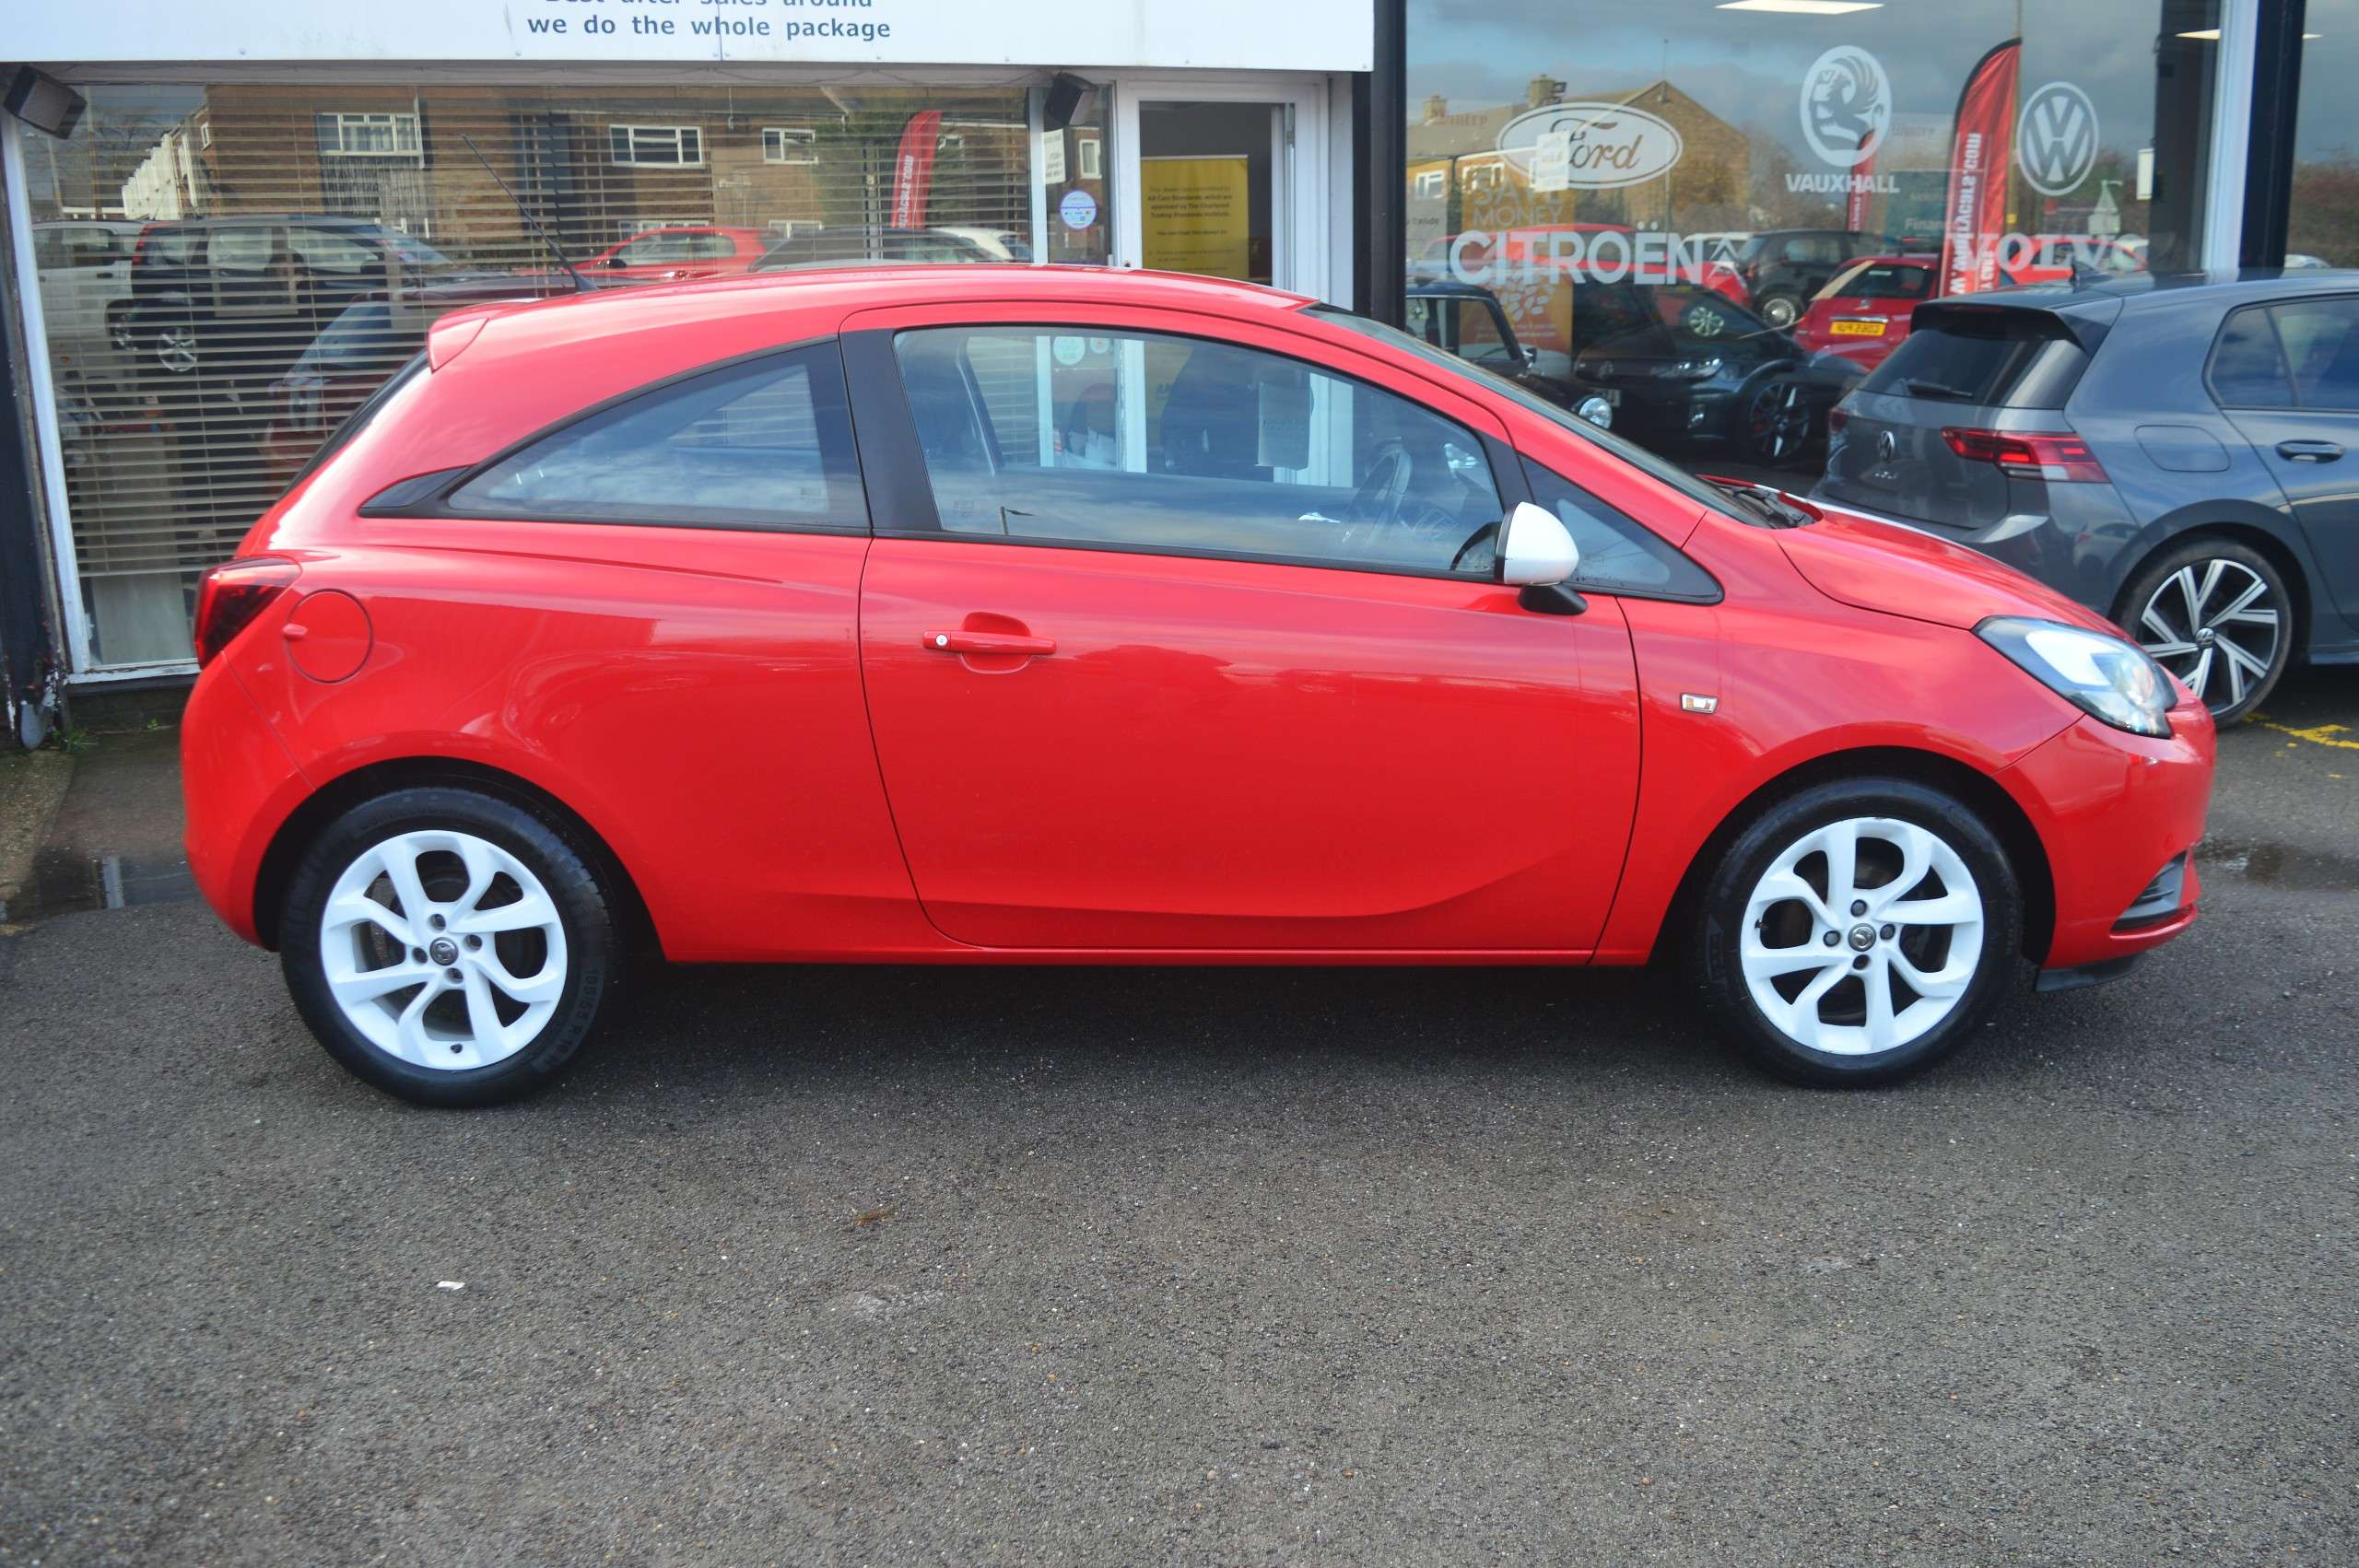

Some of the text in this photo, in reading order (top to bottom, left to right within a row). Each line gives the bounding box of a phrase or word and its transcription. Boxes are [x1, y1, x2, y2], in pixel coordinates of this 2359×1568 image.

[527, 15, 890, 41] we do the whole package
[1550, 118, 1643, 169] Ford
[1785, 173, 1901, 193] VAUXHALL
[1449, 221, 1704, 286] CITROËN
